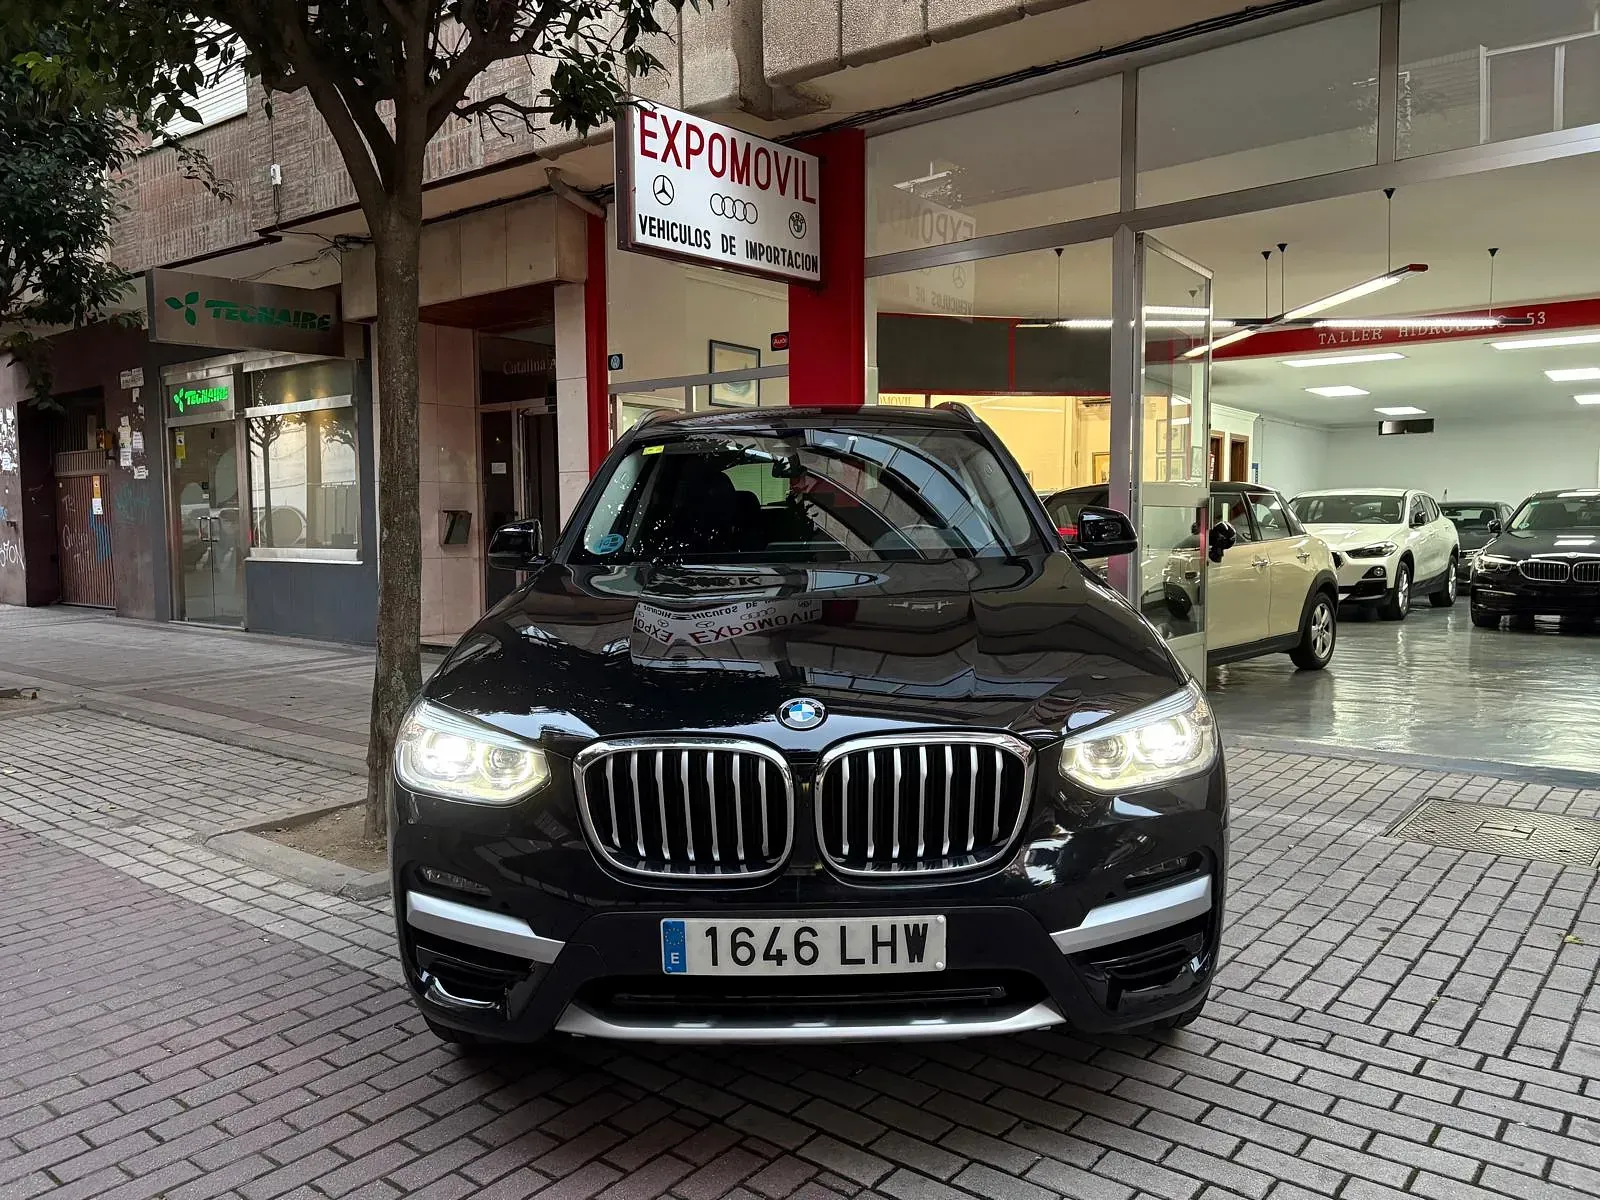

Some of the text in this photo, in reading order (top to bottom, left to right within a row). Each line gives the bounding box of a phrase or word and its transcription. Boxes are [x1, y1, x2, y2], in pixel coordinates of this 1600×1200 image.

[639, 110, 816, 205] EXPOMOVIL
[638, 214, 818, 274] VEHICULOS DE IMPORTACION
[204, 299, 332, 331] TECNAIRE
[1318, 311, 1546, 345] TALLER HIDROO 53
[184, 385, 229, 405] TECNAIRE
[671, 923, 929, 967] E 1646 LHW
